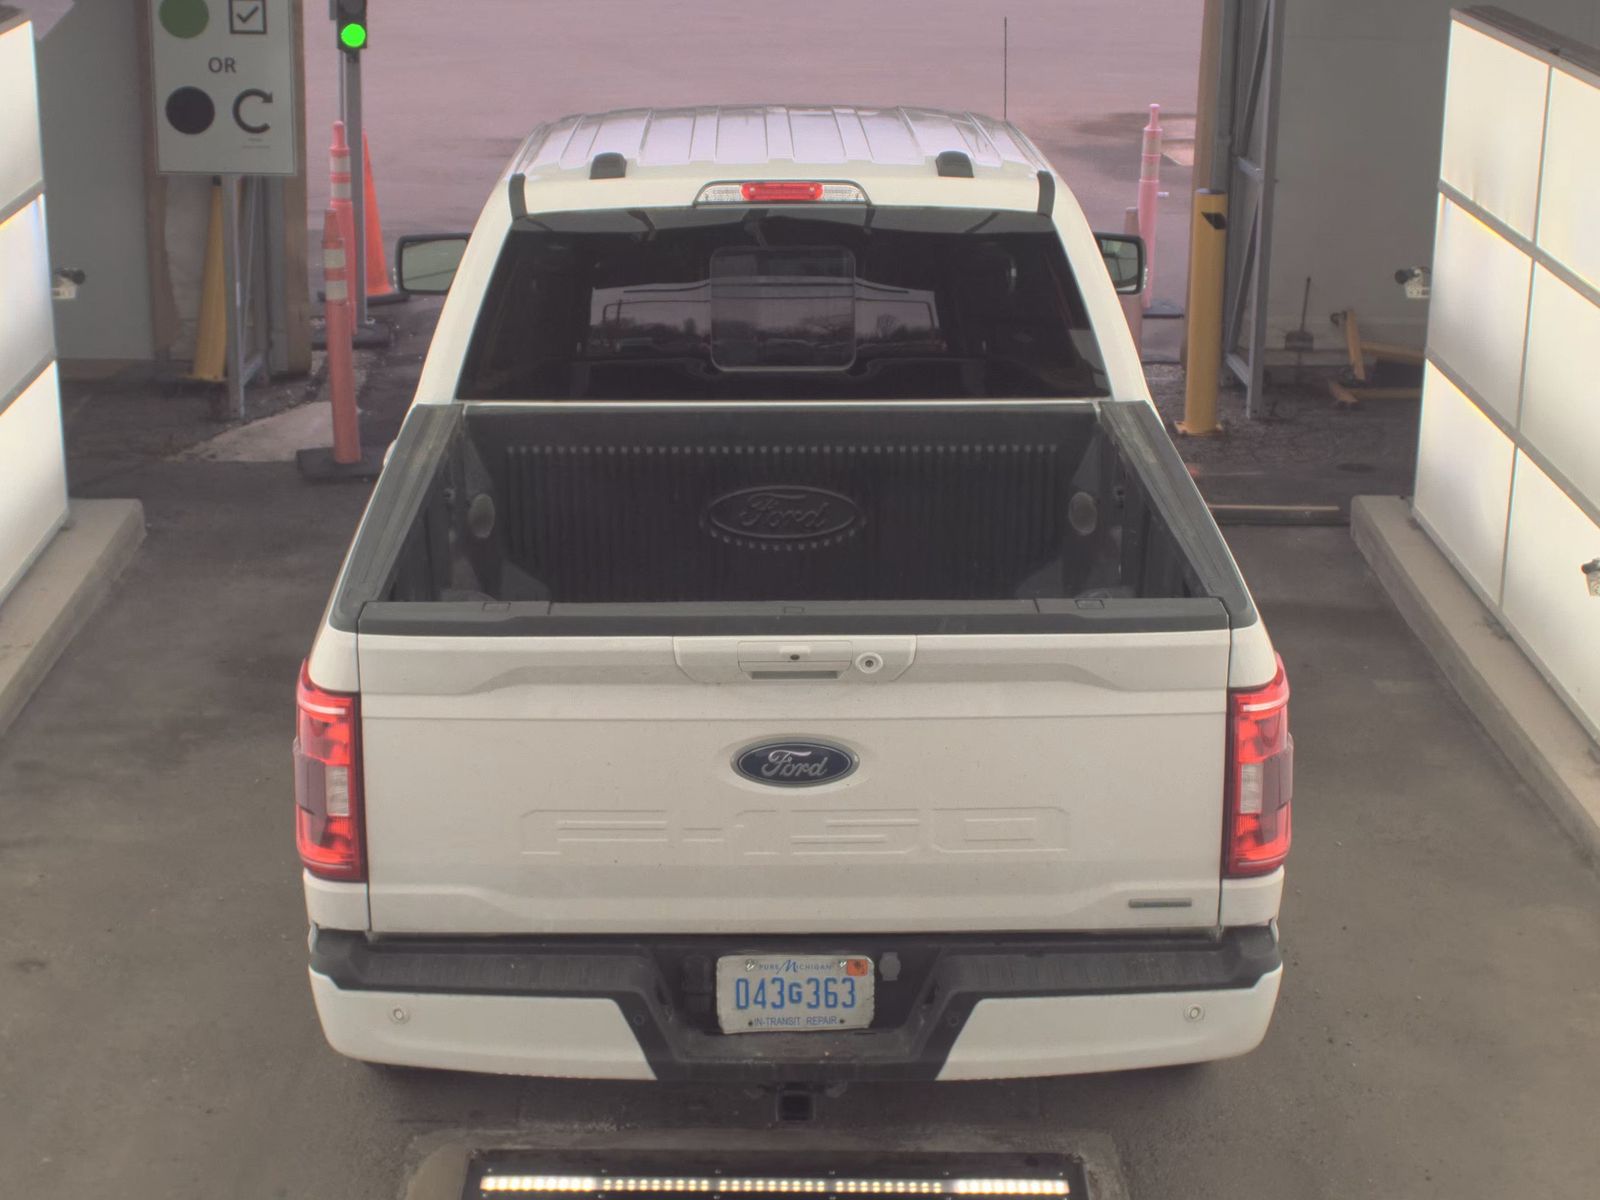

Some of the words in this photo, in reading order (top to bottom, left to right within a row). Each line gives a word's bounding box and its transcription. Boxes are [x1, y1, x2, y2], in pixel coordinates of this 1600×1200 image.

[208, 57, 236, 73] OR
[739, 492, 829, 527] Ford
[761, 749, 828, 777] Ford
[735, 977, 857, 1010] 043G363
[754, 1016, 800, 1027] IN-TRANSIT
[806, 1015, 837, 1025] REPAIR
